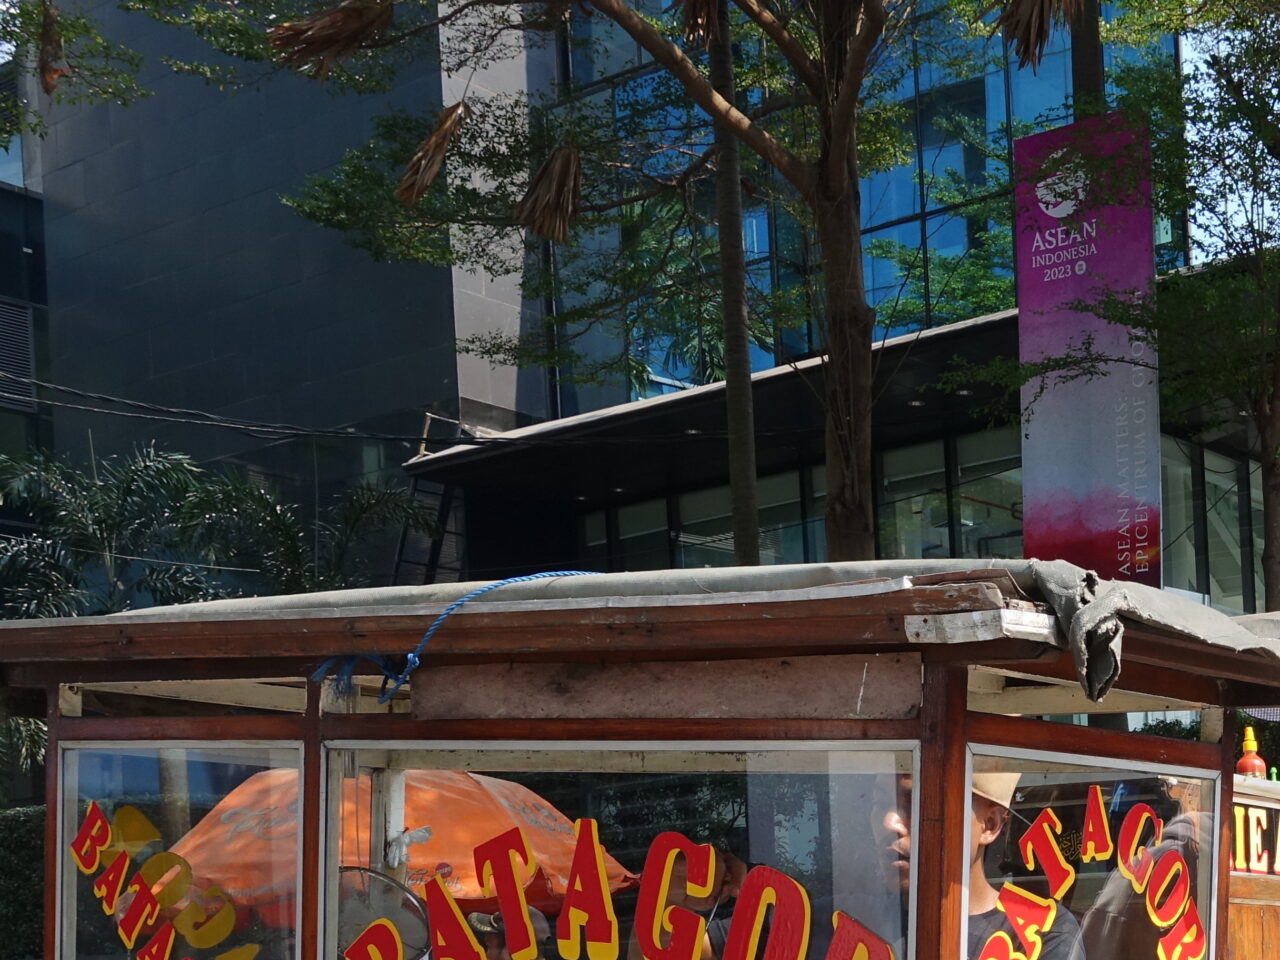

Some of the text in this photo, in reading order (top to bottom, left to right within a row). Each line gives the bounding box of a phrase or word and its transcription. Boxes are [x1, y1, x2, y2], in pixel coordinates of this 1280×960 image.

[1031, 218, 1097, 252] ASEAN
[1031, 243, 1097, 268] INDONESIA
[1043, 263, 1072, 282] 2023
[1131, 396, 1148, 424] OF
[1133, 433, 1150, 574] EPICENTRUM
[1117, 507, 1132, 577] ASEAN
[1230, 805, 1268, 875] IE
